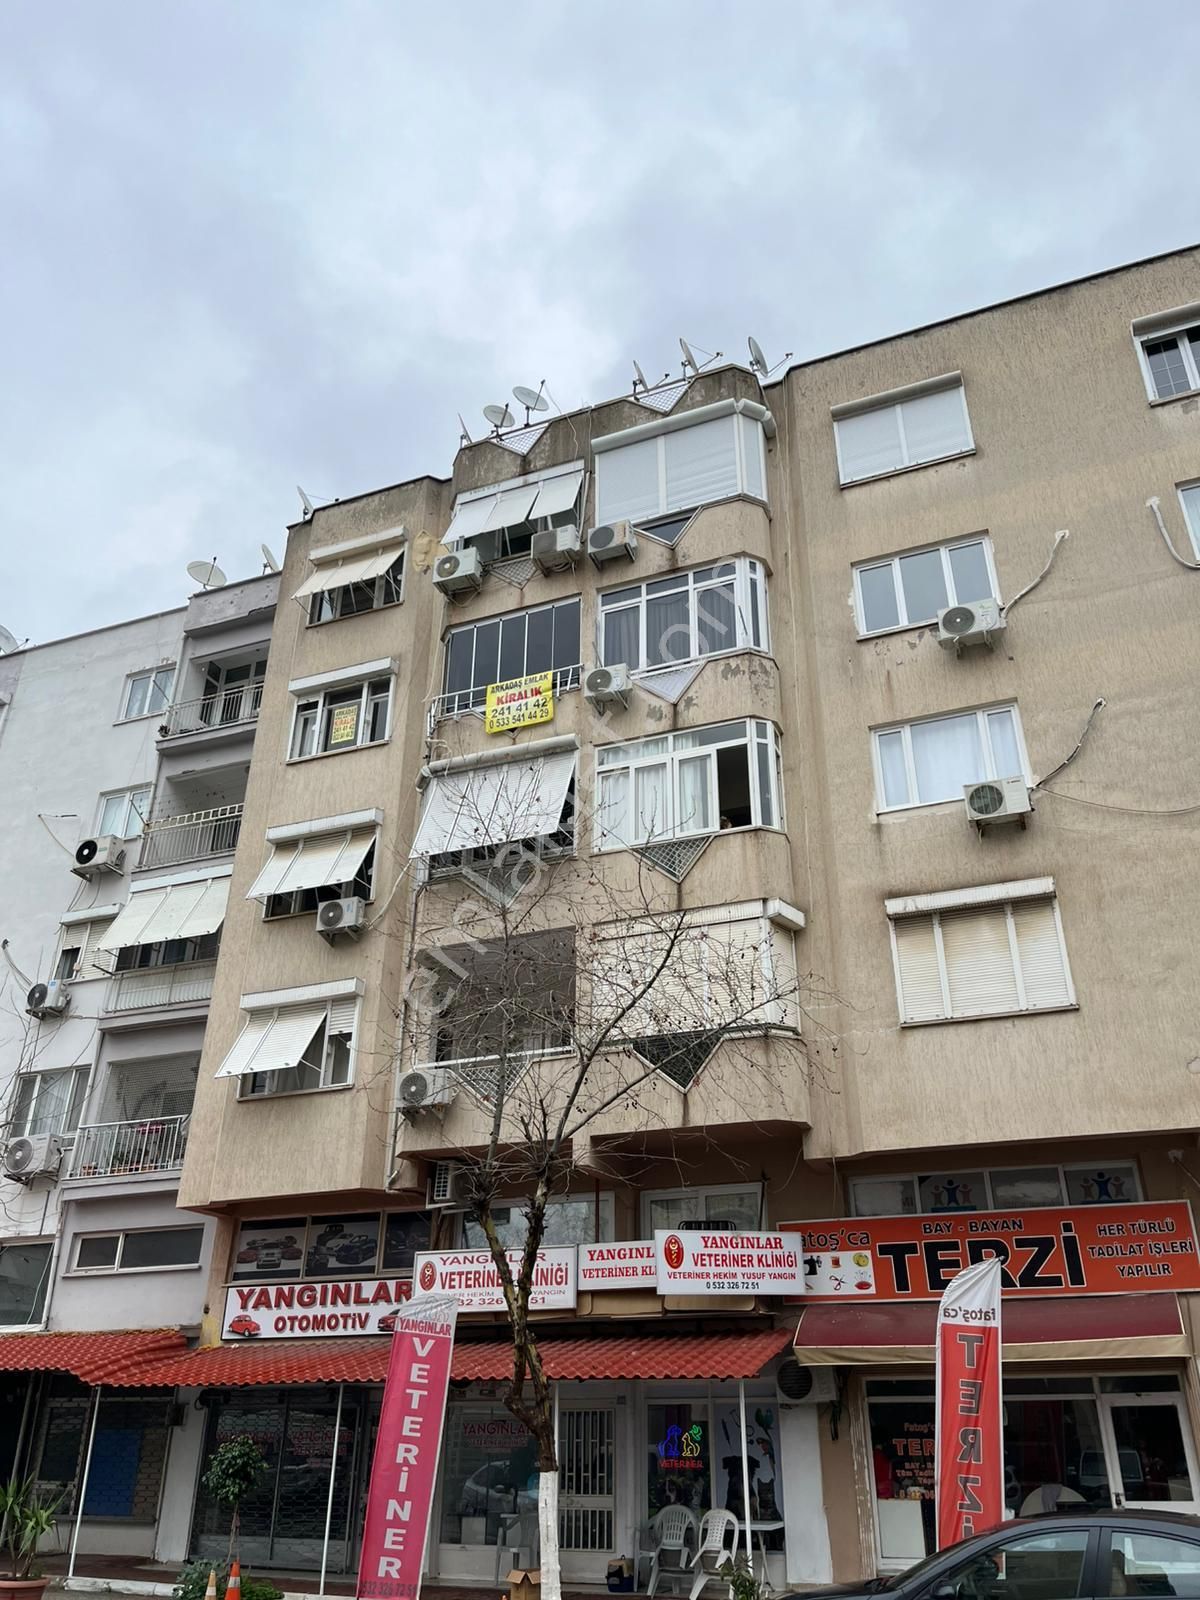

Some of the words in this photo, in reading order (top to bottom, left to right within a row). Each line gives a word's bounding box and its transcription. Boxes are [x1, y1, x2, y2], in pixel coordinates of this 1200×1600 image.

[491, 679, 524, 694] ARKADAŞ
[524, 673, 549, 685] EMLAK
[496, 686, 542, 705] KİRALIK
[491, 706, 511, 718] 241
[516, 701, 528, 712] 41
[533, 697, 548, 708] 42
[489, 720, 494, 729] 0
[496, 717, 510, 727] 533
[512, 713, 525, 724] 541
[528, 711, 537, 719] 44
[540, 708, 549, 718] 29
[922, 1222, 953, 1234] BAY
[968, 1219, 1024, 1233] BAYAN
[1097, 1223, 1127, 1236] HER
[1129, 1218, 1176, 1235] TÜRLÜ
[701, 1235, 784, 1250] YANGINLAR
[800, 1229, 871, 1251] atoş'ca
[1088, 1242, 1145, 1258] TADİLAT
[1148, 1239, 1194, 1257] İŞLERİ
[587, 1247, 655, 1261] YANGINL
[692, 1251, 754, 1268] VETERİNER
[757, 1251, 798, 1268] KLİNİĞİ
[440, 1266, 512, 1290] VETERİNE
[582, 1265, 637, 1279] VETERİNER
[667, 1271, 711, 1280] VETERİNER
[713, 1271, 737, 1280] HEKİM
[741, 1272, 766, 1280] YUSUF
[768, 1272, 796, 1280] YANGIN
[1116, 1263, 1173, 1279] YAPILIR
[236, 1280, 413, 1311] YANGINLAR
[478, 1297, 504, 1305] 326
[399, 1316, 452, 1337] YANGINLAR
[892, 1438, 936, 1456] TER
